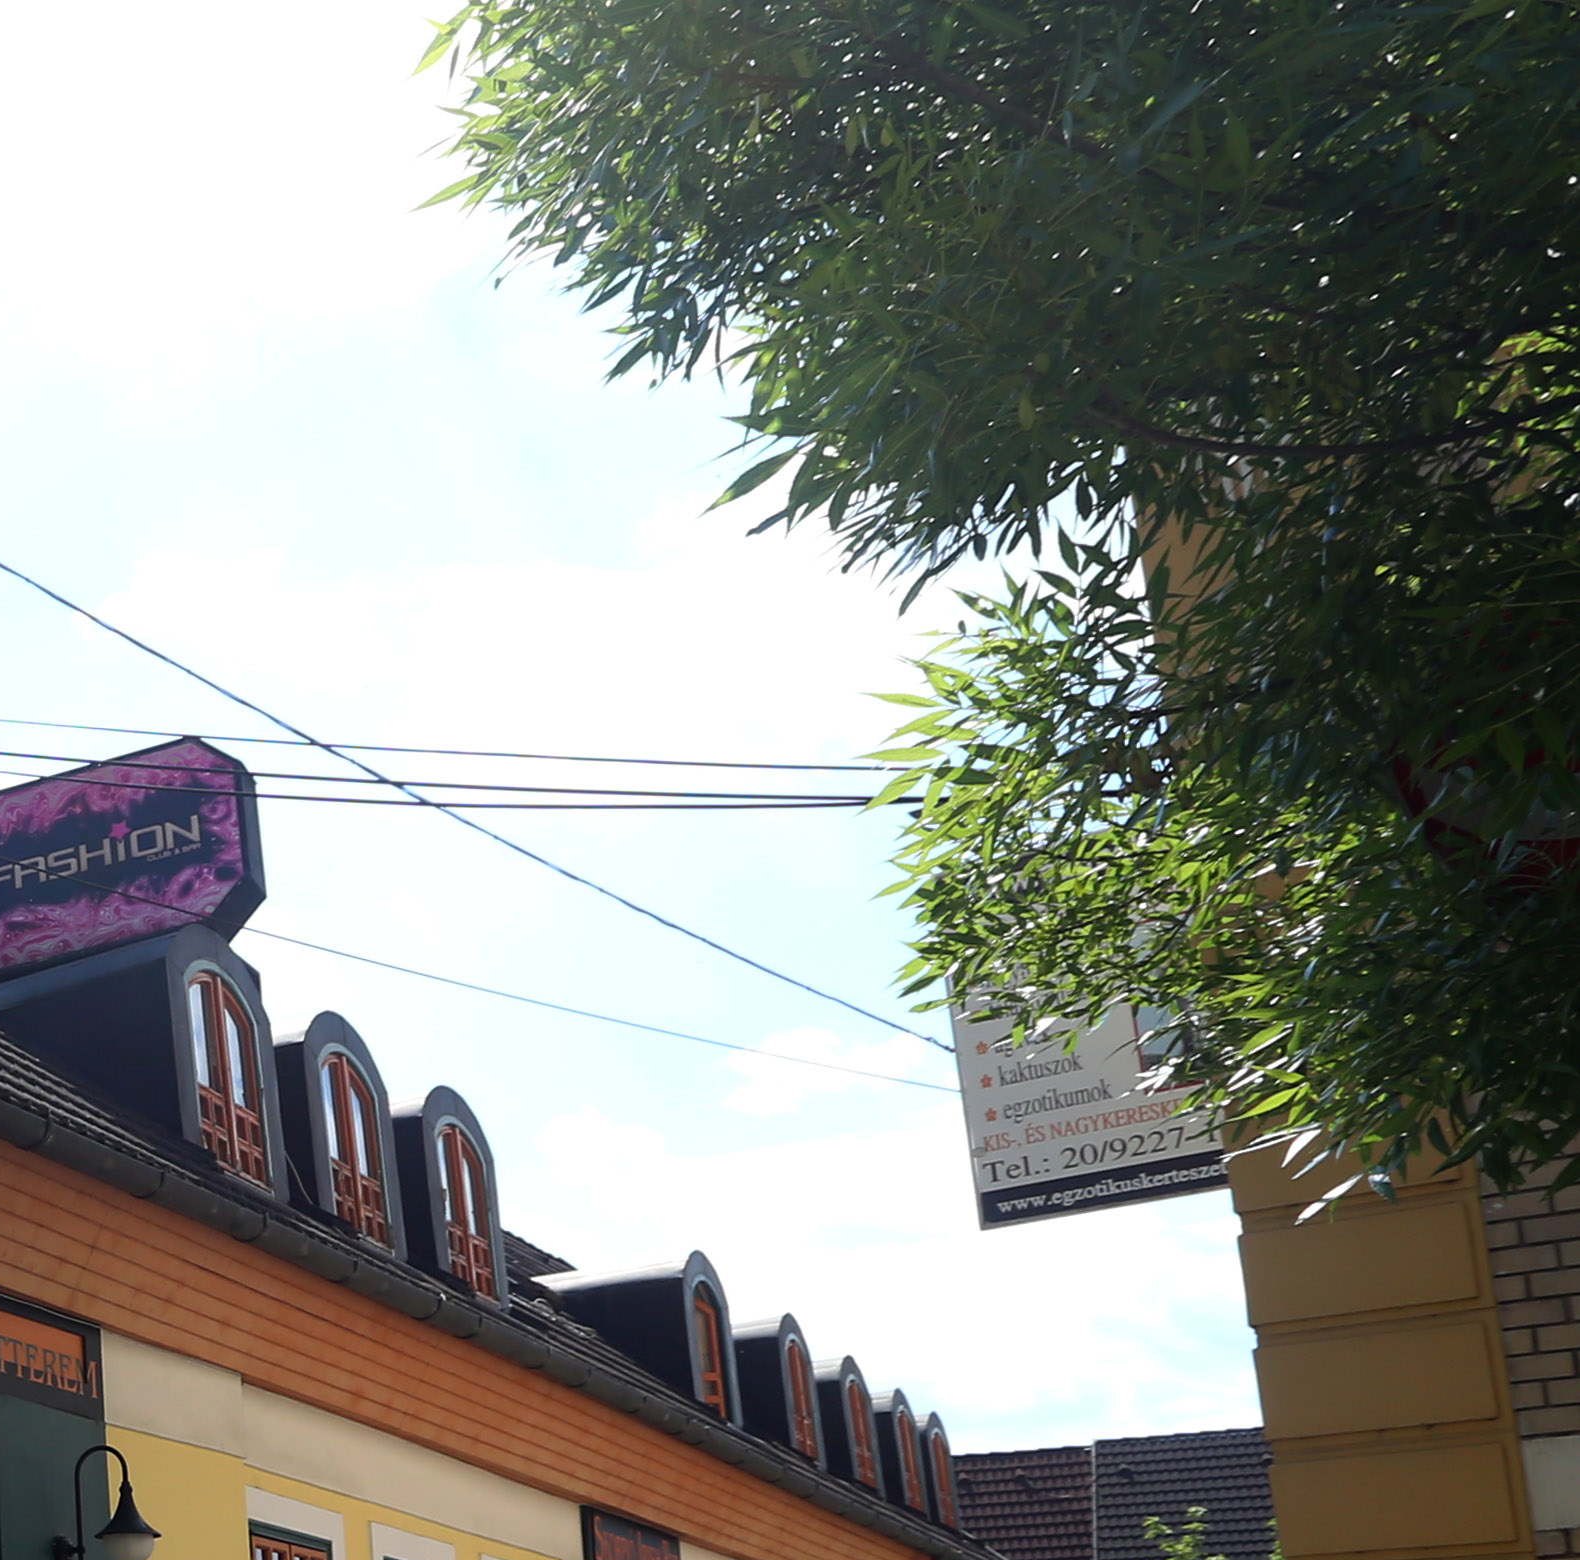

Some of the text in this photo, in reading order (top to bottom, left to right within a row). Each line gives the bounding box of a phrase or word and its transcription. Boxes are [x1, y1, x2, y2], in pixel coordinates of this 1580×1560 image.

[998, 1053, 1083, 1087] kaktuszok
[1003, 1079, 1113, 1123] egzotikumok
[1025, 1124, 1045, 1145] ÉS
[983, 1156, 1050, 1183] Tel.:
